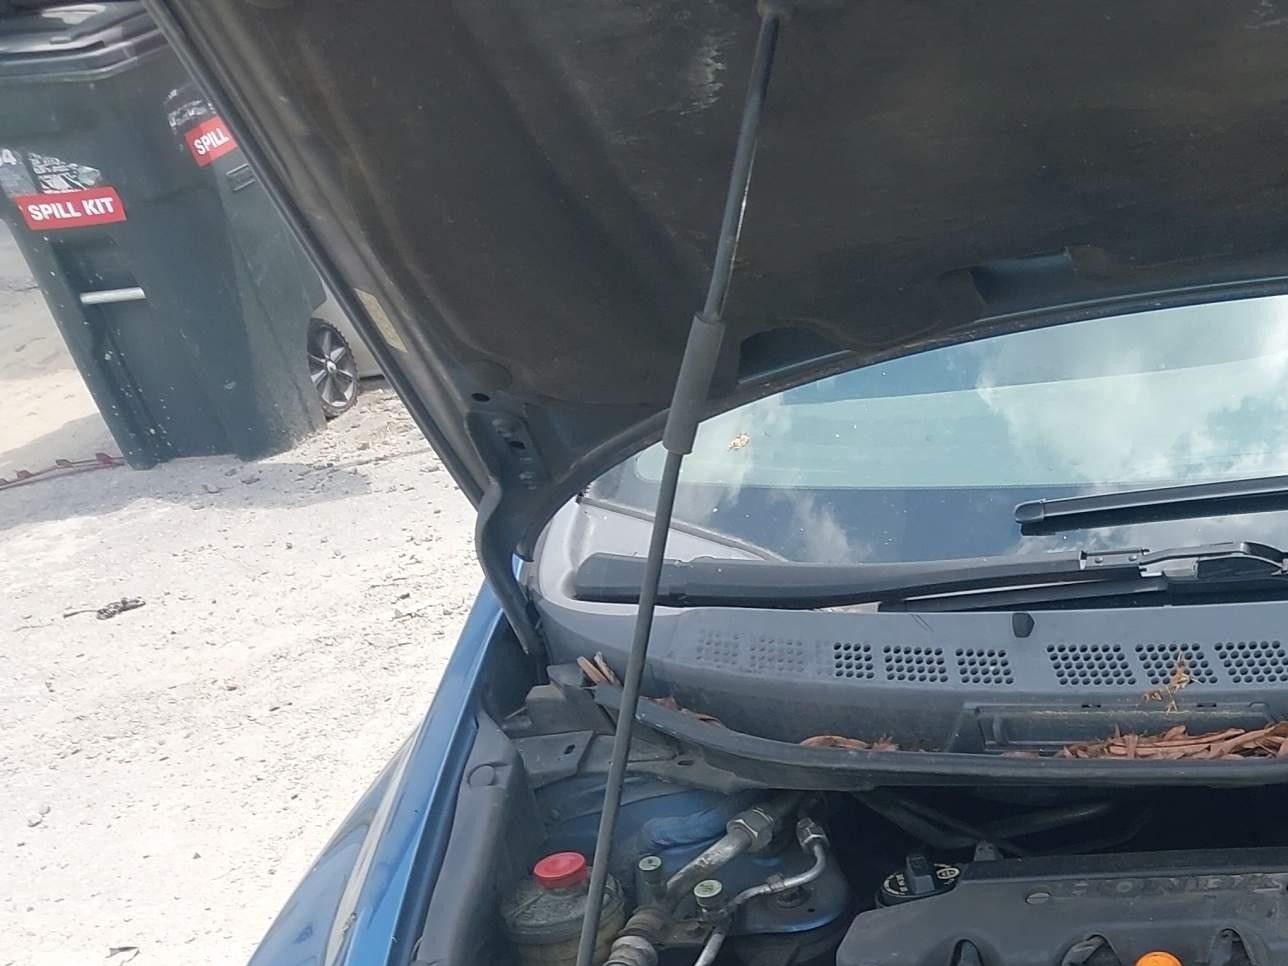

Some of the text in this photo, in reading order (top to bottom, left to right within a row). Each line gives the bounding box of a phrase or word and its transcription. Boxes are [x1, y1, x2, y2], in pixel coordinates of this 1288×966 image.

[194, 128, 230, 155] SPILL
[28, 196, 114, 221] SPILL KIT
